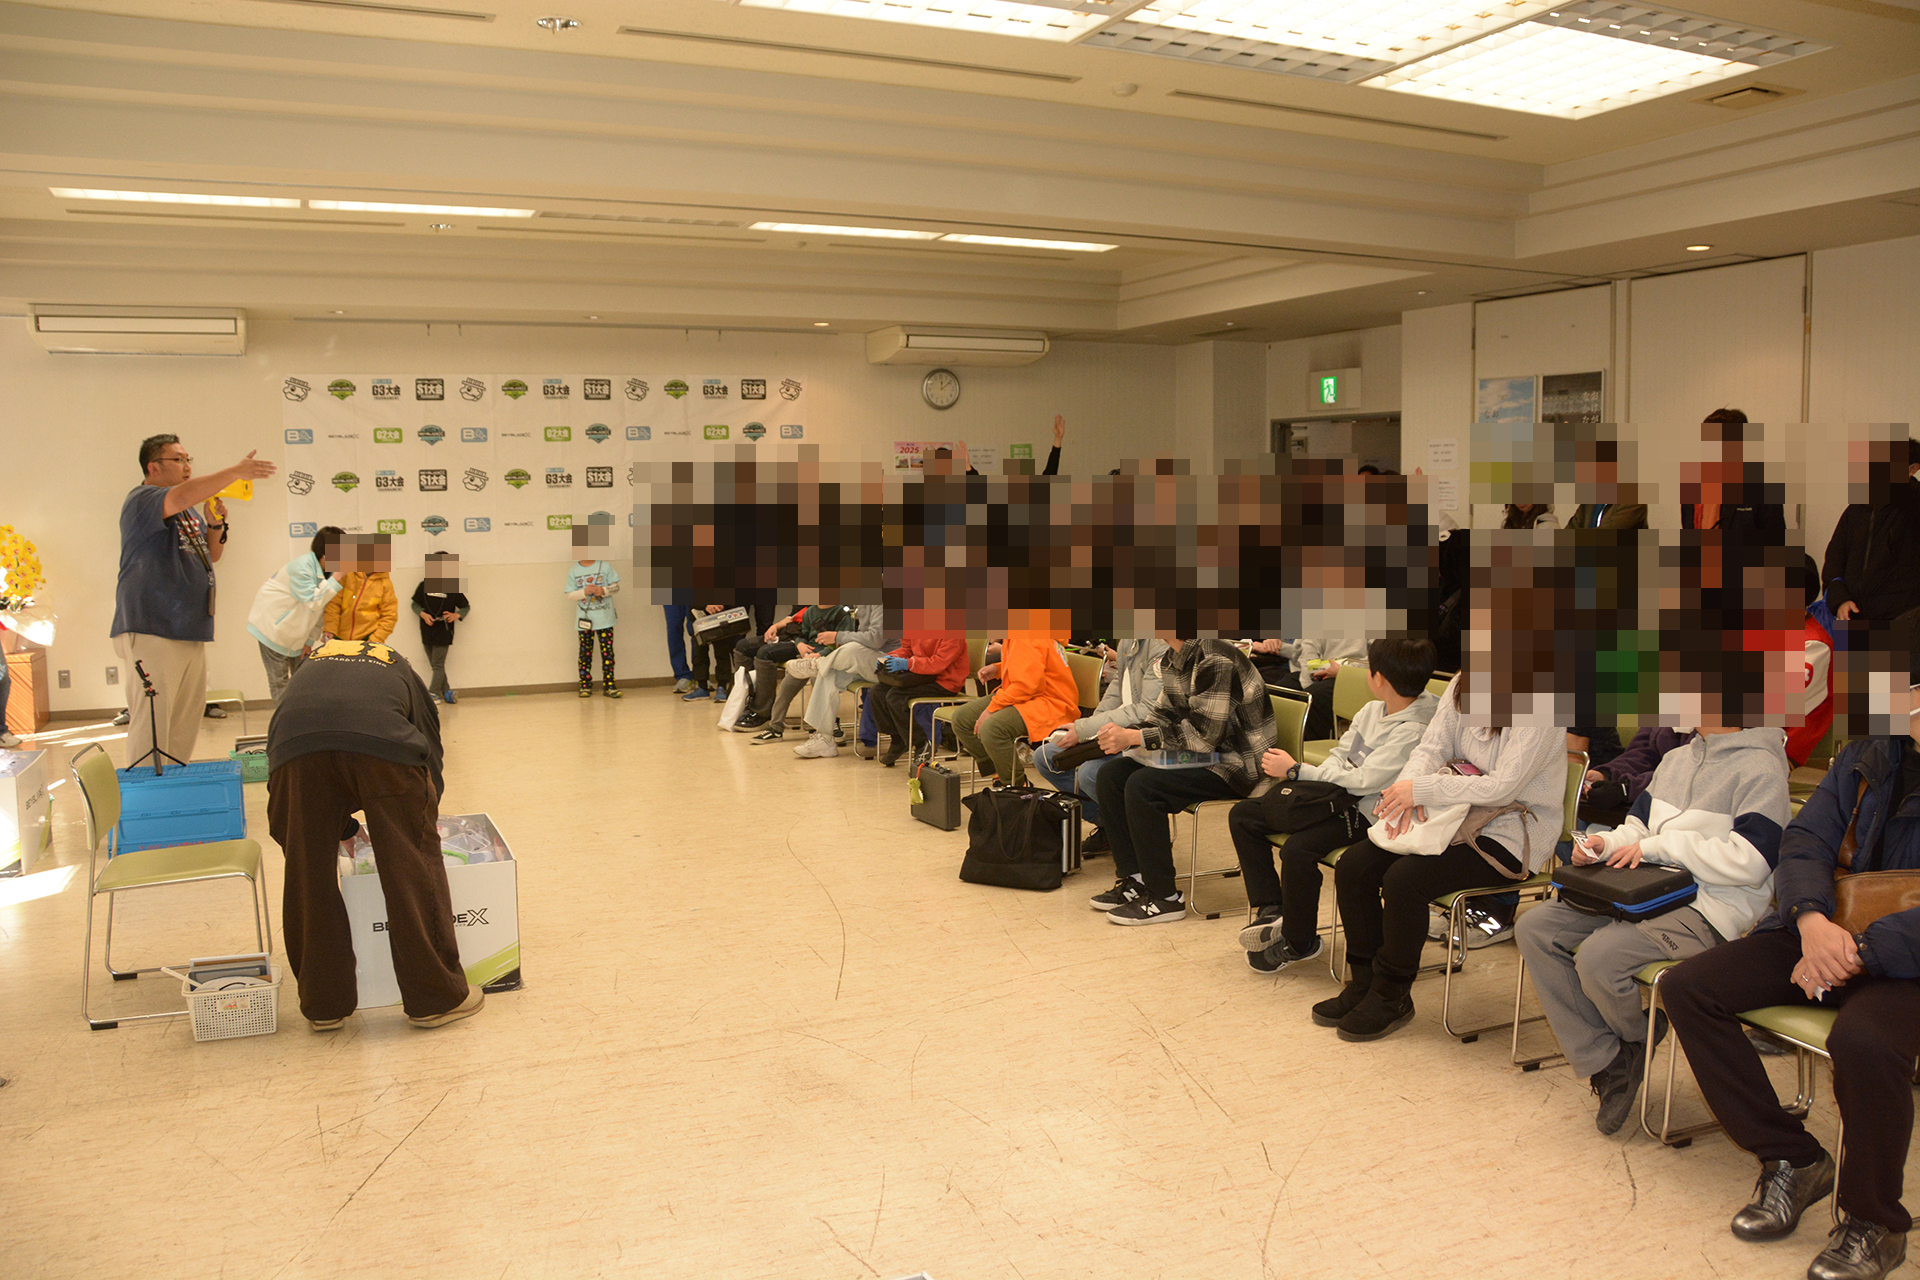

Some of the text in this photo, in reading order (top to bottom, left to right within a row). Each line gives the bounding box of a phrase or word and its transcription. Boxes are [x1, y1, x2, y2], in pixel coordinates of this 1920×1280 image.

[372, 385, 401, 396] G3大会
[417, 384, 443, 395] S1大会
[543, 385, 570, 396] G3大会
[703, 385, 728, 395] G3大会
[900, 446, 920, 454] 2025
[375, 476, 404, 487] G3大会
[420, 474, 447, 486] S1大会
[546, 474, 572, 484] G3大会
[587, 472, 612, 483] S1大会
[1478, 916, 1502, 936] N
